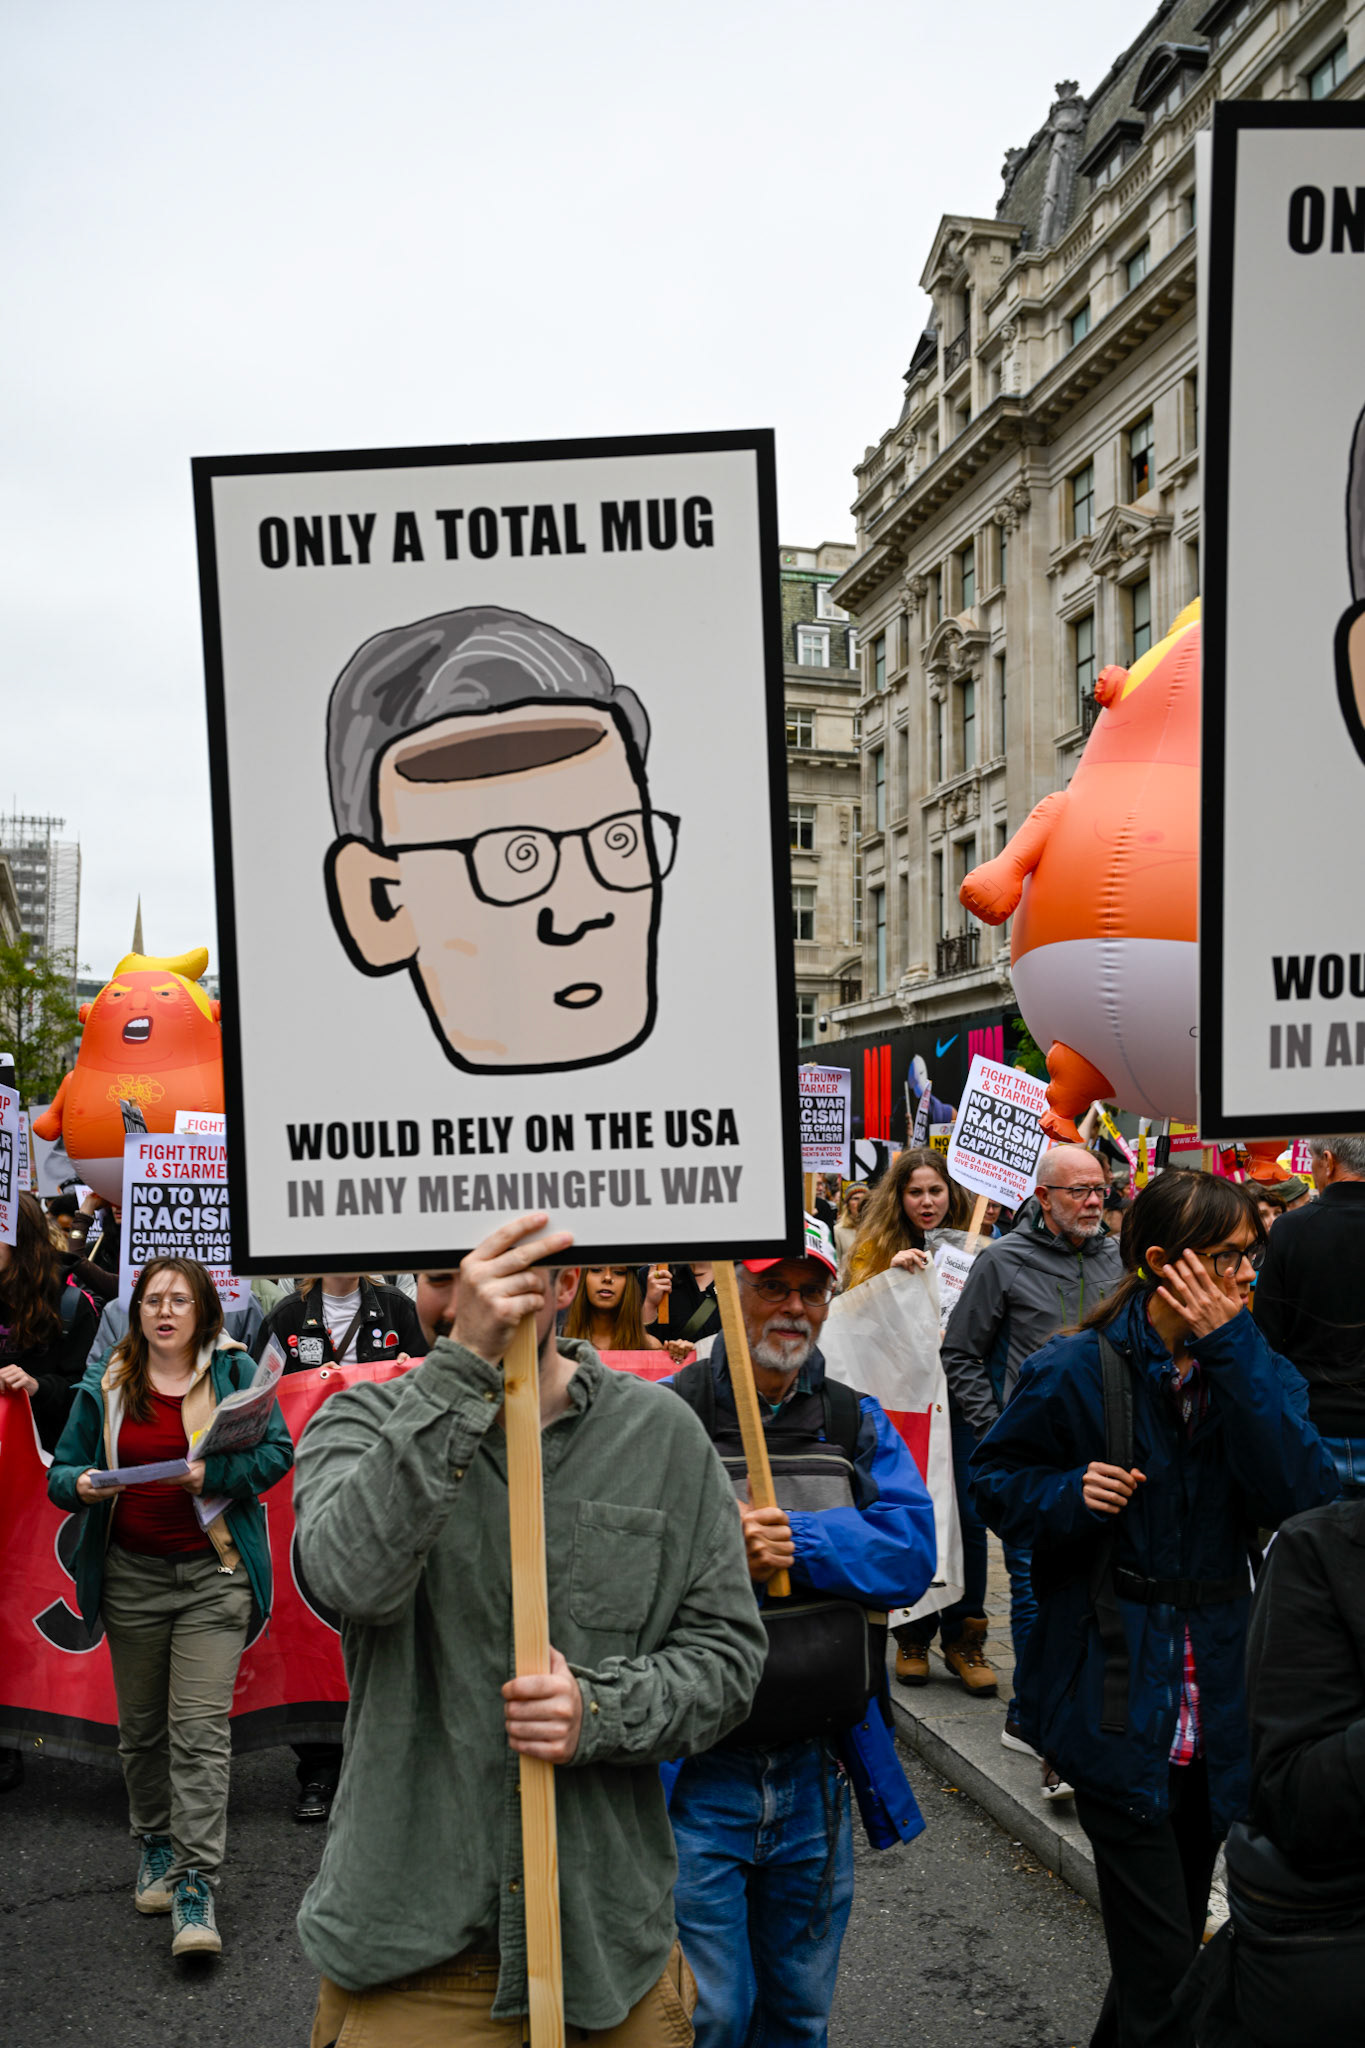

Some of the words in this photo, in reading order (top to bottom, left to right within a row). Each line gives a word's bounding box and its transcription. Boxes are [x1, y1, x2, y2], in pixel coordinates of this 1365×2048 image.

[259, 512, 377, 569] ONLY
[392, 511, 424, 563] A
[435, 503, 587, 560] TOTAL
[600, 495, 714, 552] MUG
[1270, 1023, 1311, 1069] IN
[810, 1073, 842, 1083] TRUMP
[980, 1066, 1013, 1085] FIGHT
[816, 1098, 844, 1109] WAR
[970, 1092, 992, 1111] NO
[994, 1101, 1012, 1119] TO
[982, 1080, 990, 1091] &
[993, 1085, 1044, 1113] STARMER
[187, 1119, 225, 1133] FIGHT
[286, 1119, 420, 1161] WOULD
[432, 1115, 514, 1156] RELY
[525, 1113, 574, 1153] ON
[585, 1110, 654, 1150] THE
[665, 1108, 740, 1148] USA
[814, 1125, 842, 1133] CHAOS
[966, 1105, 1043, 1151] RACISM
[139, 1144, 186, 1161] FIGHT
[959, 1134, 1034, 1174] CAPITALISM
[963, 1123, 1004, 1147] CLIMATE
[1004, 1138, 1036, 1161] CHAOS
[145, 1162, 157, 1178] &
[162, 1163, 229, 1179] STARME
[954, 1157, 969, 1169] GIVE
[969, 1162, 1002, 1181] STUDENTS
[1002, 1175, 1007, 1183] A
[1008, 1178, 1026, 1192] VOICE
[956, 1150, 976, 1165] BUILD
[977, 1158, 982, 1166] A
[983, 1160, 999, 1172] NEW
[999, 1165, 1019, 1181] PARTY
[1019, 1174, 1027, 1185] TO
[132, 1186, 163, 1205] NO
[167, 1187, 194, 1205] TO
[287, 1179, 324, 1218] IN
[336, 1176, 407, 1216] ANY
[418, 1168, 652, 1214] MEANINGFUL
[660, 1165, 743, 1206] WAY
[132, 1232, 192, 1245] CLIMATE
[945, 1256, 970, 1273] Socialist
